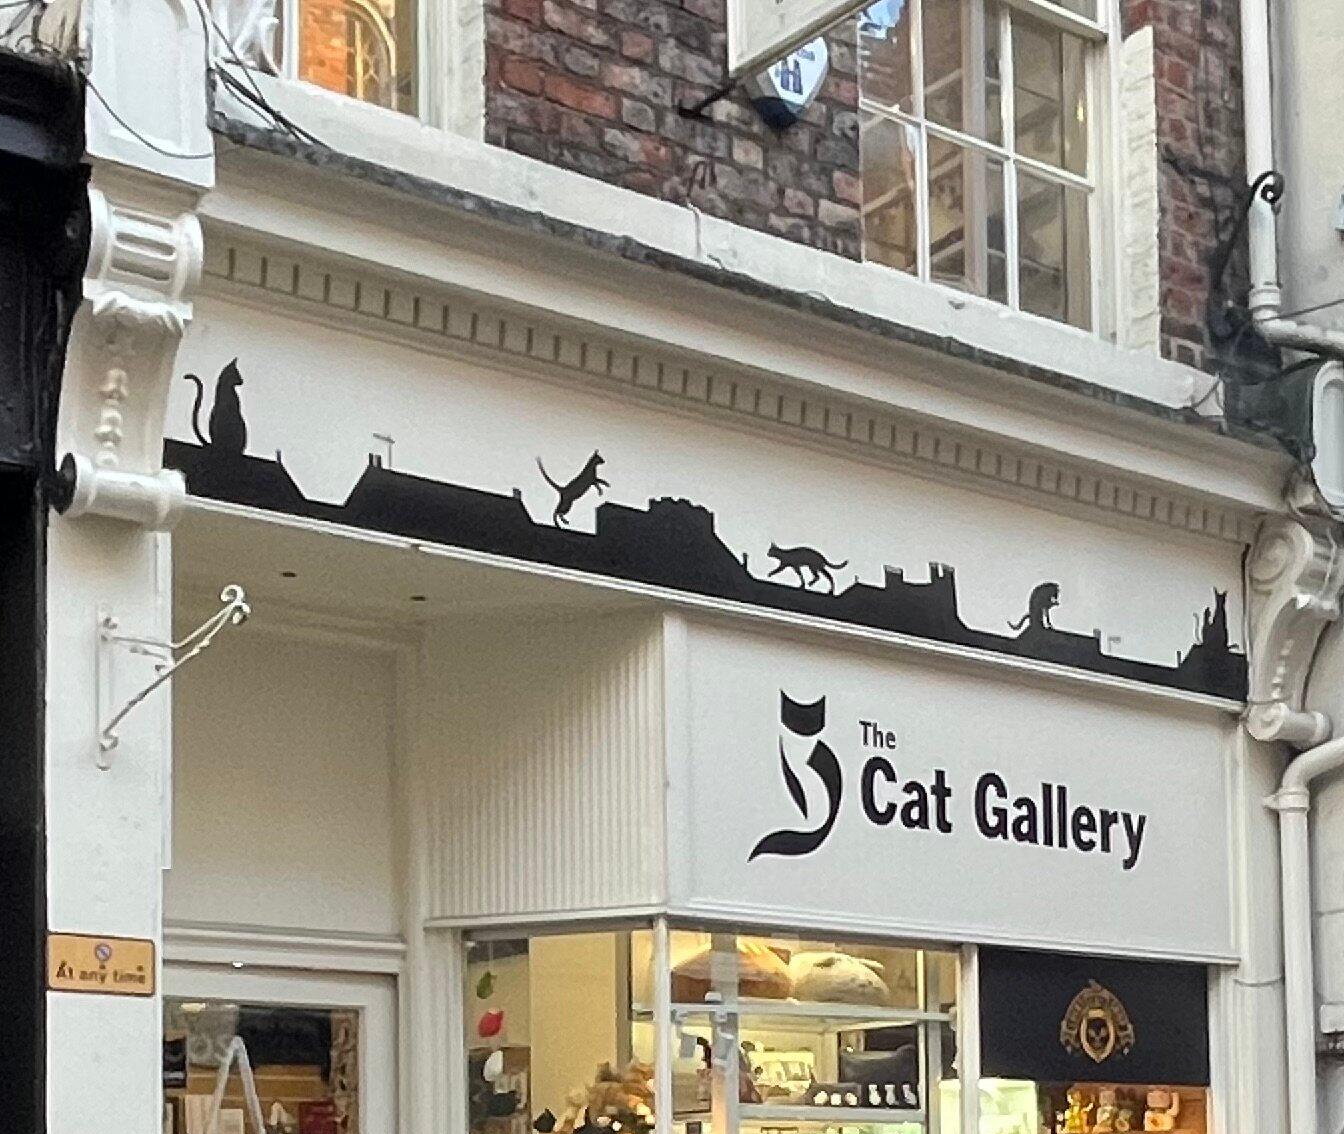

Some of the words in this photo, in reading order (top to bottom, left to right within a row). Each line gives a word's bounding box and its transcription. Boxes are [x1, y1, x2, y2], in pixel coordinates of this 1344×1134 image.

[859, 720, 897, 750] The
[860, 756, 953, 833] Cat
[974, 772, 1147, 870] Gallery
[56, 960, 74, 980] At
[78, 970, 108, 986] any
[113, 967, 146, 985] time
